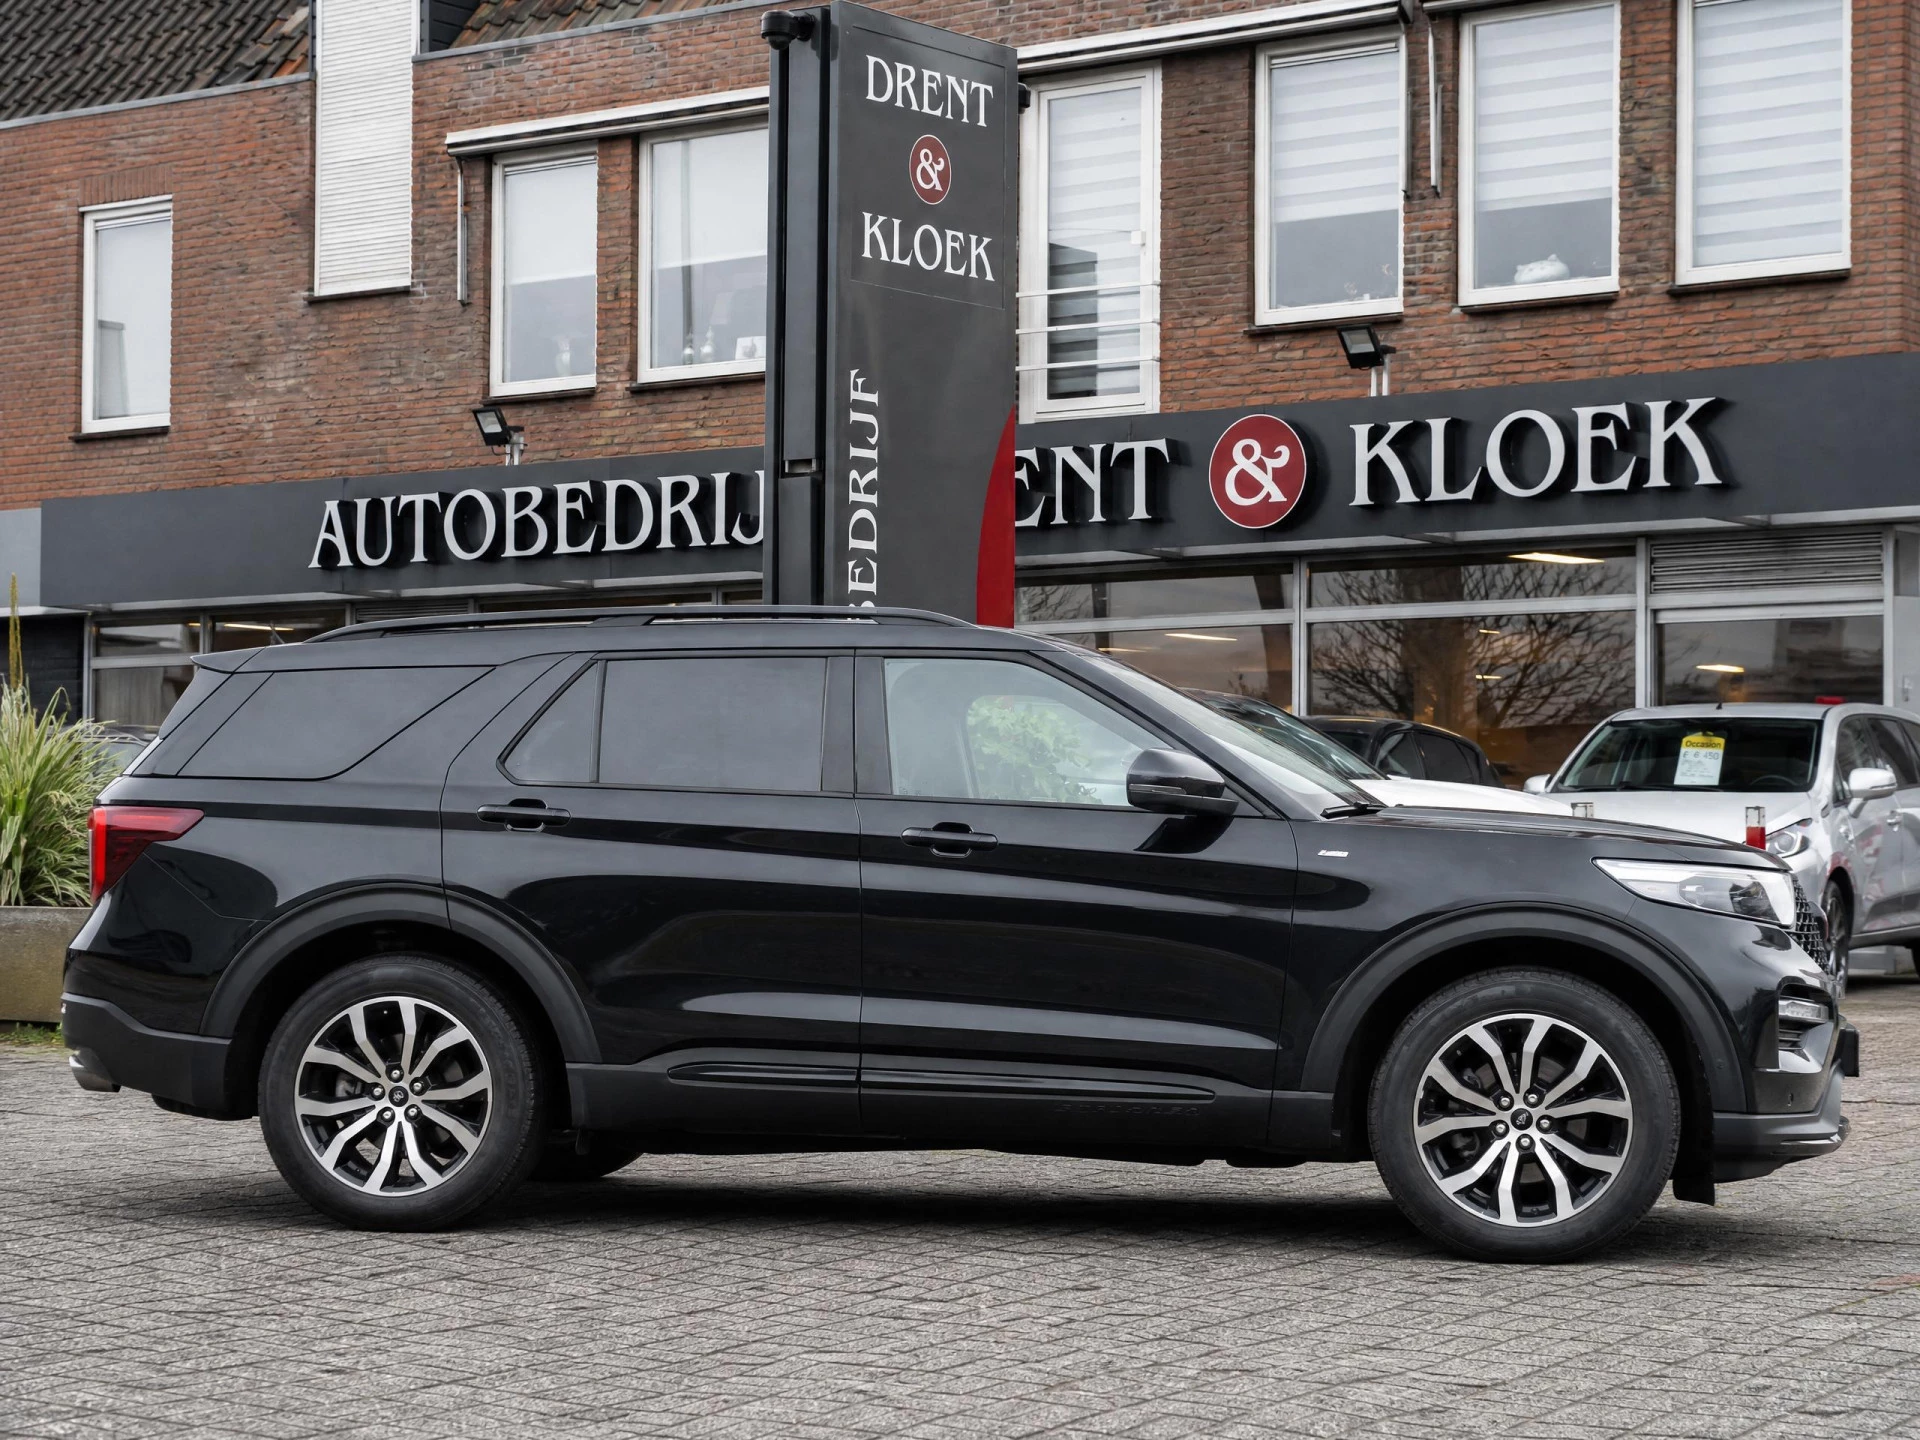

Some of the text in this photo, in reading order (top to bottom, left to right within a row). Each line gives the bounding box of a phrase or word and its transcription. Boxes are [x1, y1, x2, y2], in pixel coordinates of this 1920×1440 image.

[866, 54, 994, 128] DRENT
[916, 148, 945, 192] &
[861, 211, 995, 282] KLOEK
[1225, 438, 1290, 506] &
[1349, 396, 1722, 506] KLOEK
[848, 368, 879, 607] EDRIJF
[1685, 740, 1722, 749] Occasion
